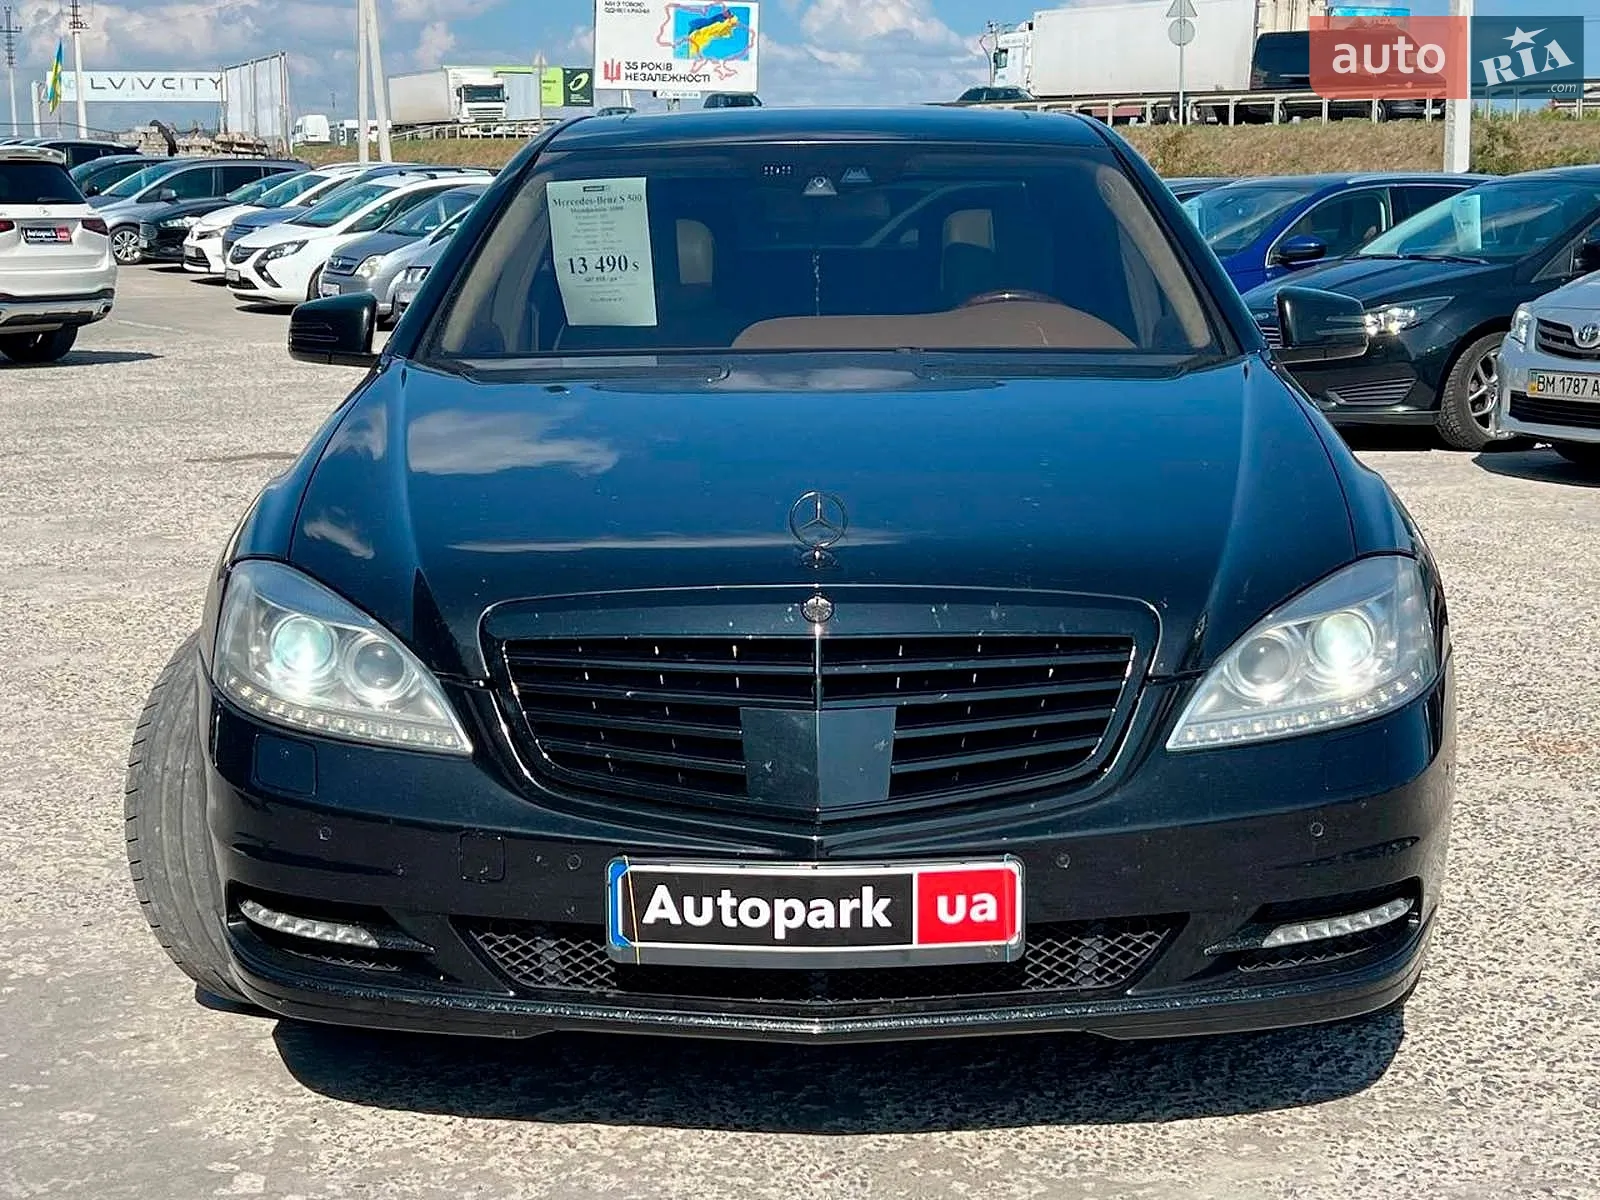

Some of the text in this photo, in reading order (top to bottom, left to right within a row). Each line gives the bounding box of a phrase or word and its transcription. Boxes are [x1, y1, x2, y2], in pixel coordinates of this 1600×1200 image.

[625, 61, 673, 71] 35 РОКІВ
[625, 73, 711, 83] НЕЗАЛЕЖНОСТІ
[568, 256, 589, 275] 13
[594, 254, 628, 273] 490
[1560, 376, 1588, 396] 1787
[641, 884, 998, 940] Autopark ua
